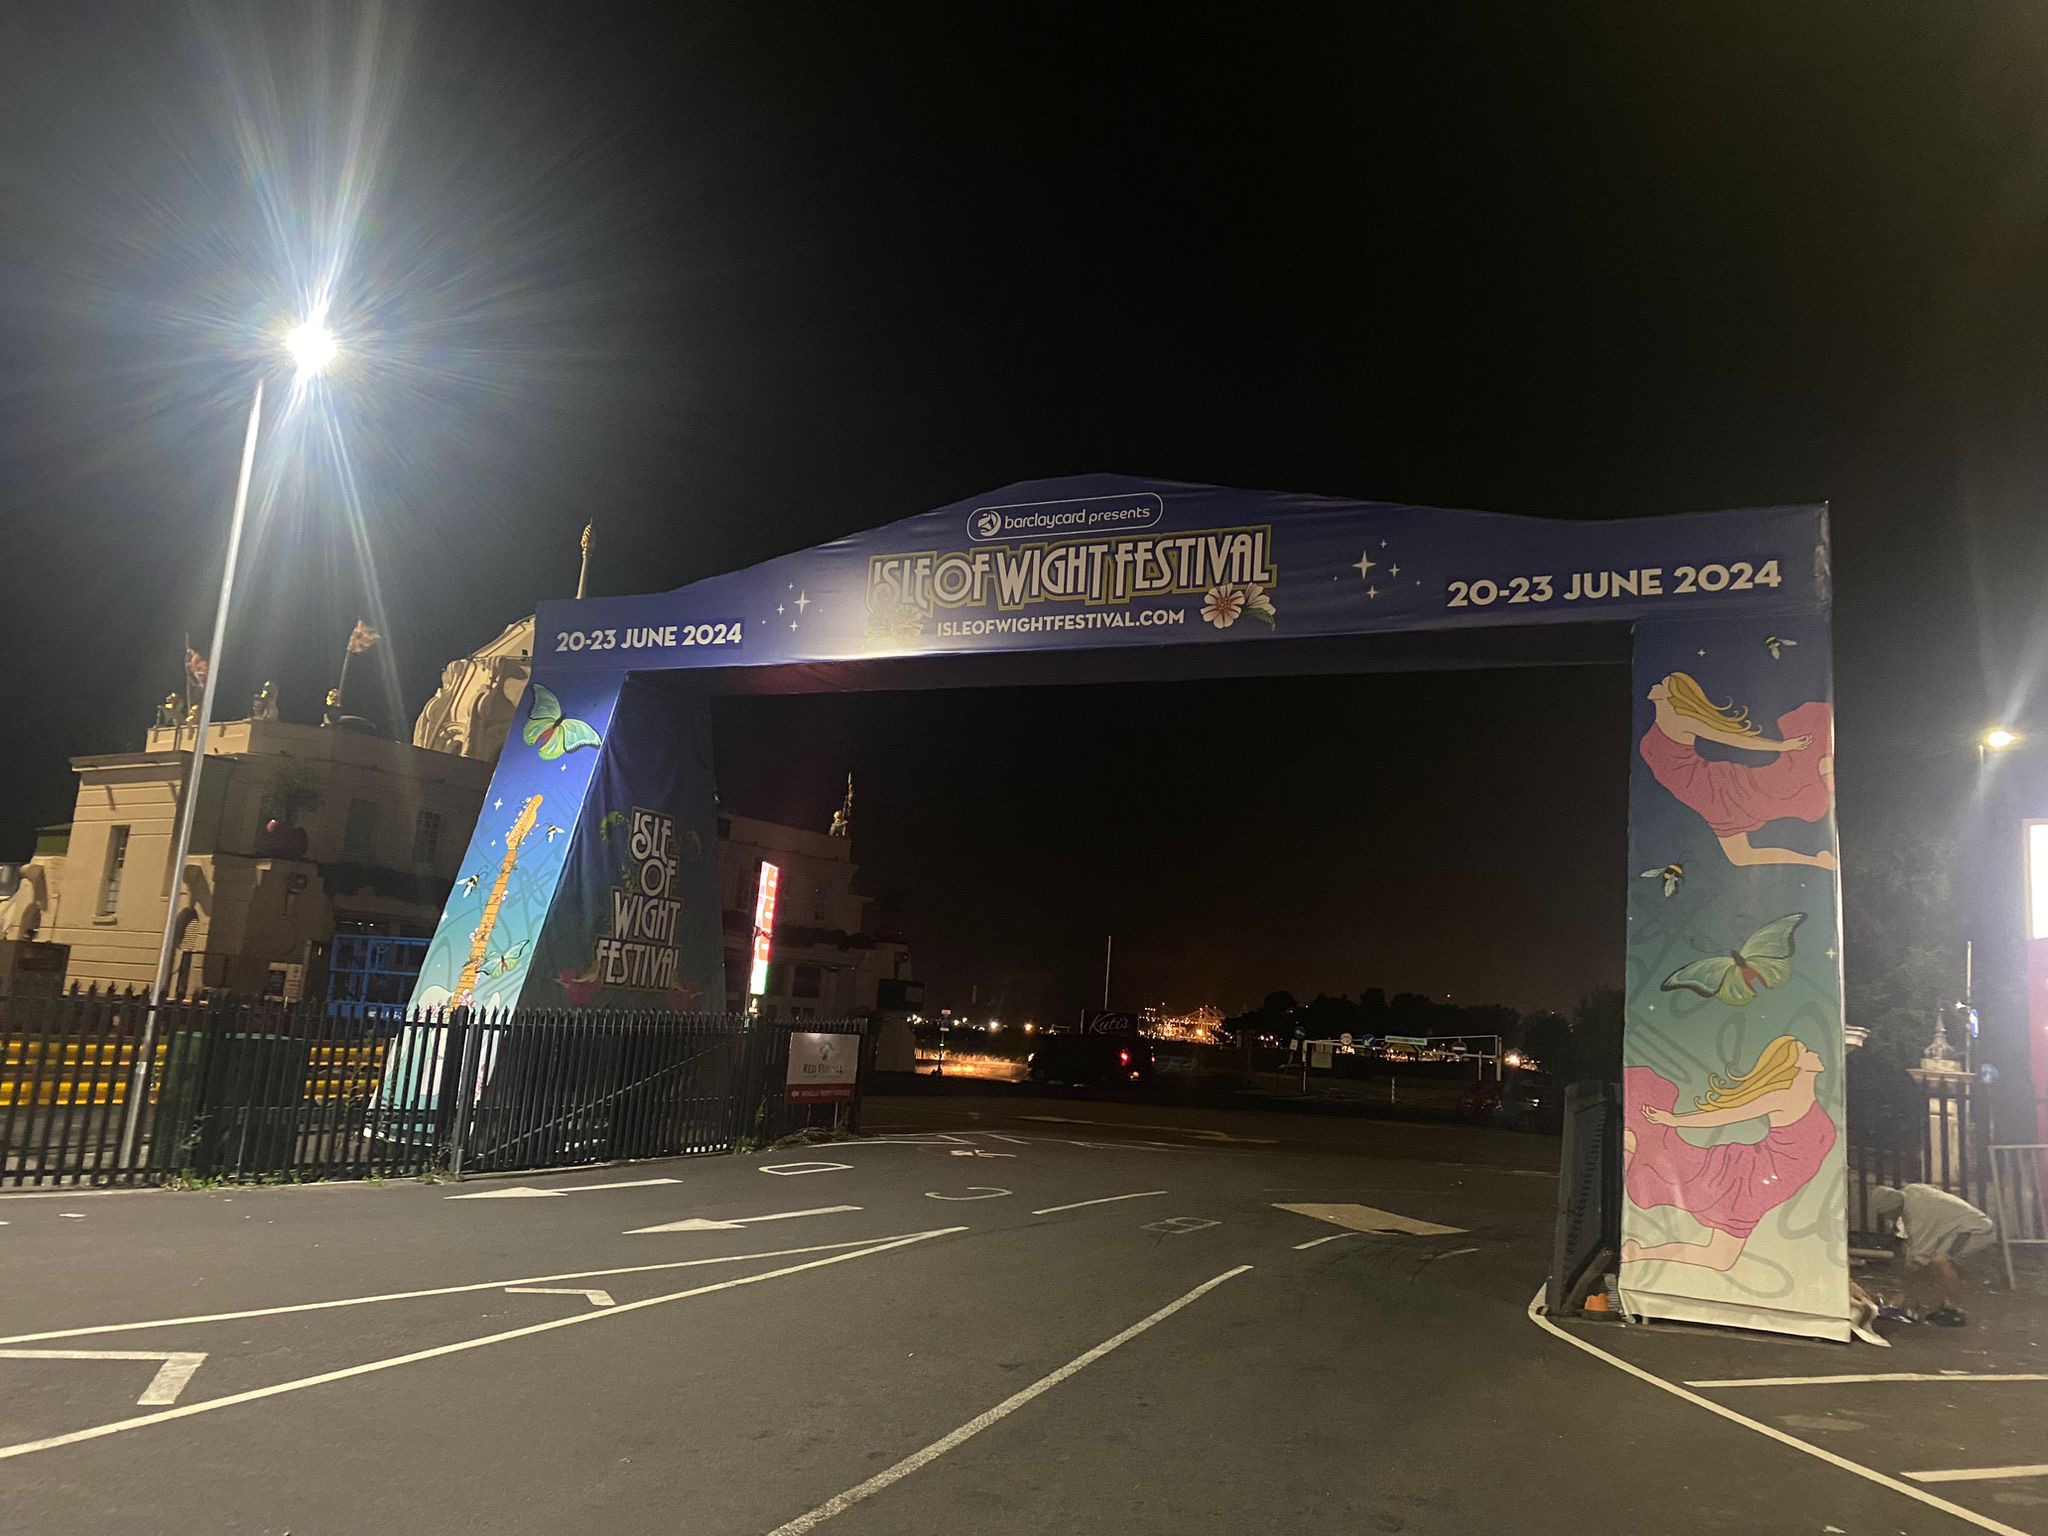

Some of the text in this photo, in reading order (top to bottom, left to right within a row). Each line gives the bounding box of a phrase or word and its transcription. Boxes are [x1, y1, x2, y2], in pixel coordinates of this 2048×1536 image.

[1004, 506, 1150, 530] barclaycard presents
[873, 532, 1270, 609] ISLE OF WIGHT FESTIVAL
[1447, 560, 1782, 607] 20-23 JUNE 2024
[555, 623, 742, 652] 20-23 JUNE 2024
[937, 608, 1185, 637] ISLEOFWIGHTFESTIVAL.COM
[631, 812, 673, 862] ISLE
[640, 858, 677, 898] OF
[614, 891, 681, 946] WIGHT
